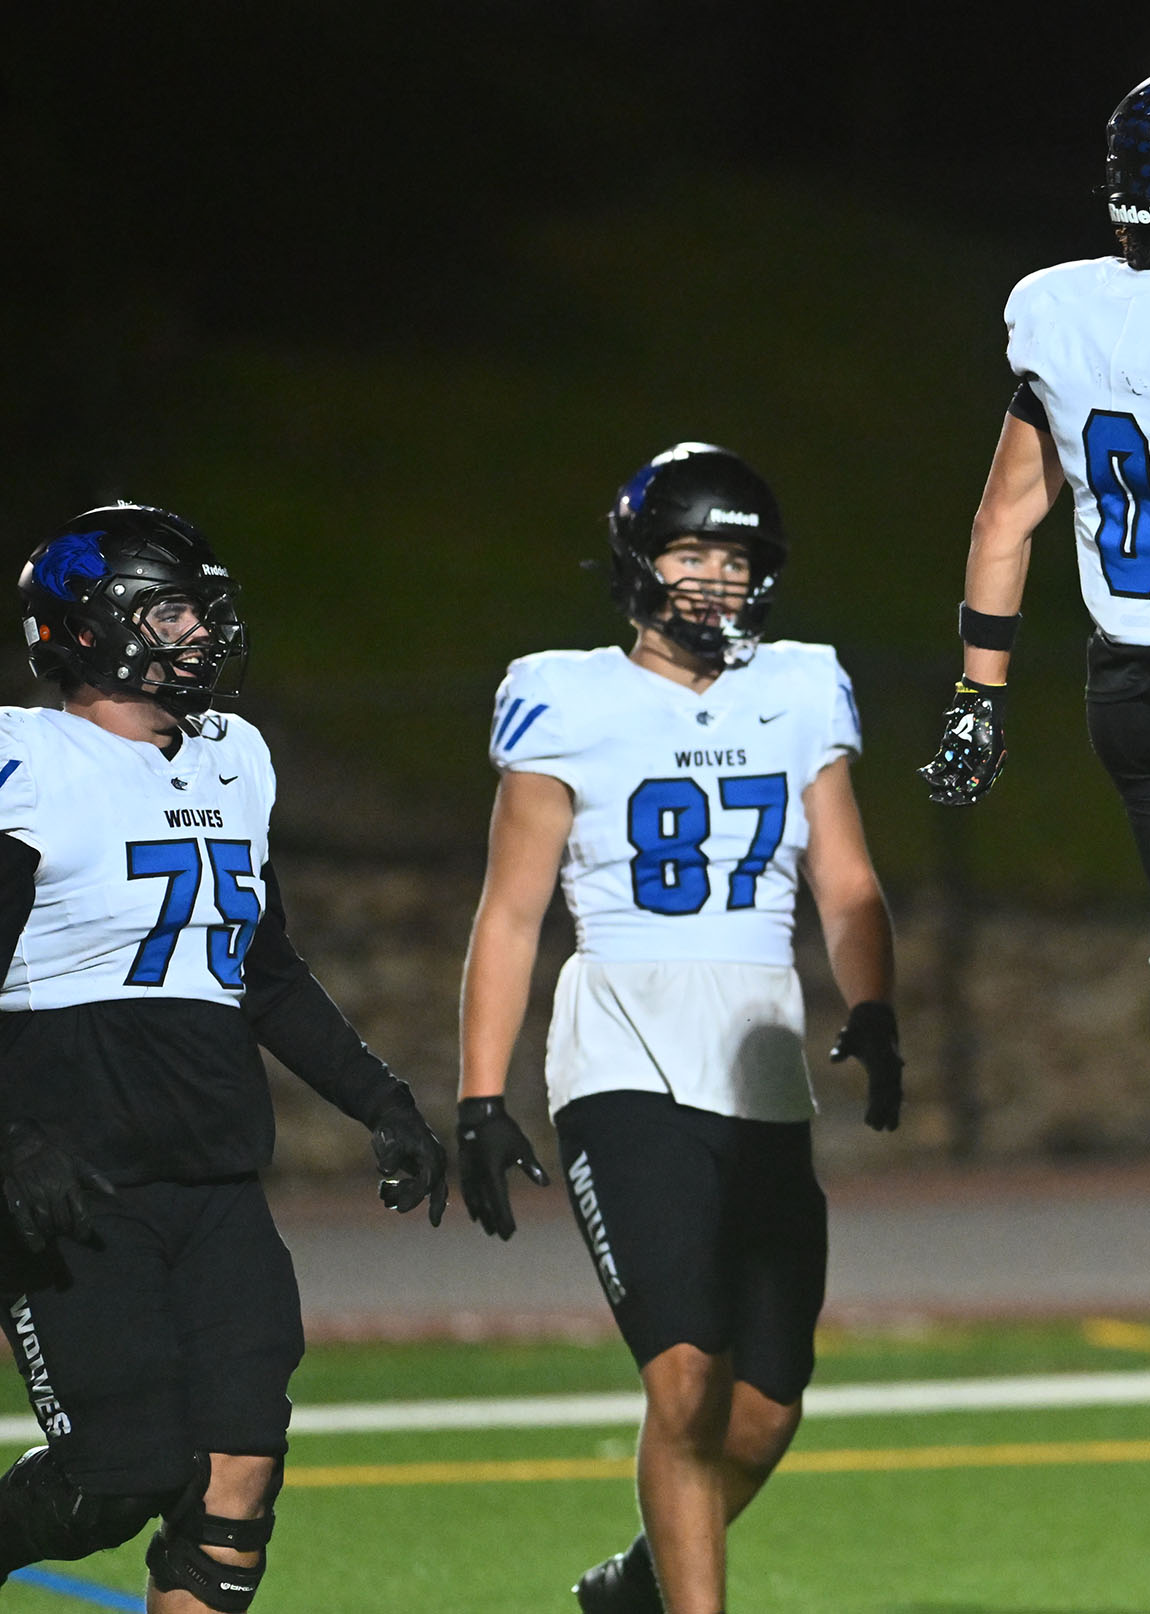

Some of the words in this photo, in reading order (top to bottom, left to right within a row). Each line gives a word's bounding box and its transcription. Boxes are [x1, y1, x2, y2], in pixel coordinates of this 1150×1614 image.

[675, 748, 747, 768] WOLVES
[164, 808, 224, 829] WOLVES
[627, 772, 790, 916] 87
[122, 838, 265, 989] 75
